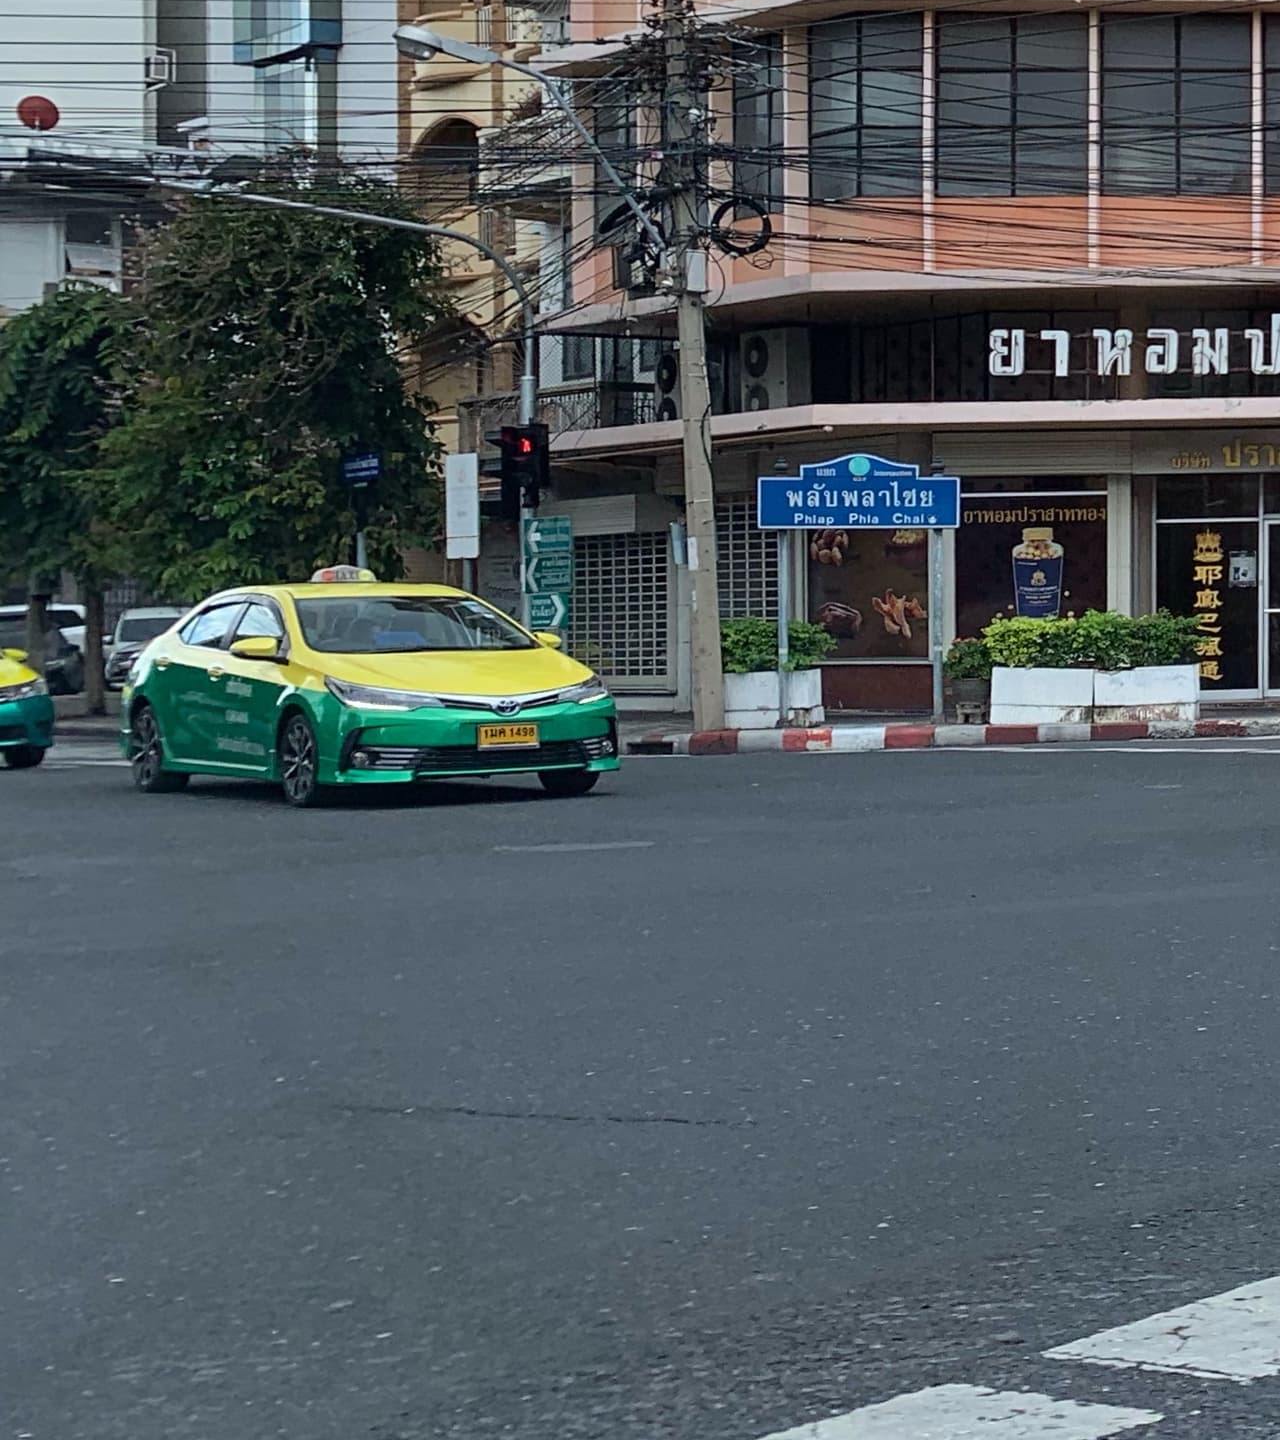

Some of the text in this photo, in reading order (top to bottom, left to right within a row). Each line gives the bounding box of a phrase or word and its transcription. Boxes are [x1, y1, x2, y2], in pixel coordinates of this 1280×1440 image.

[786, 481, 934, 508] พลับพลาไชย
[963, 506, 1106, 524] ยาหอมปราสาททอง
[510, 726, 535, 737] 1498
